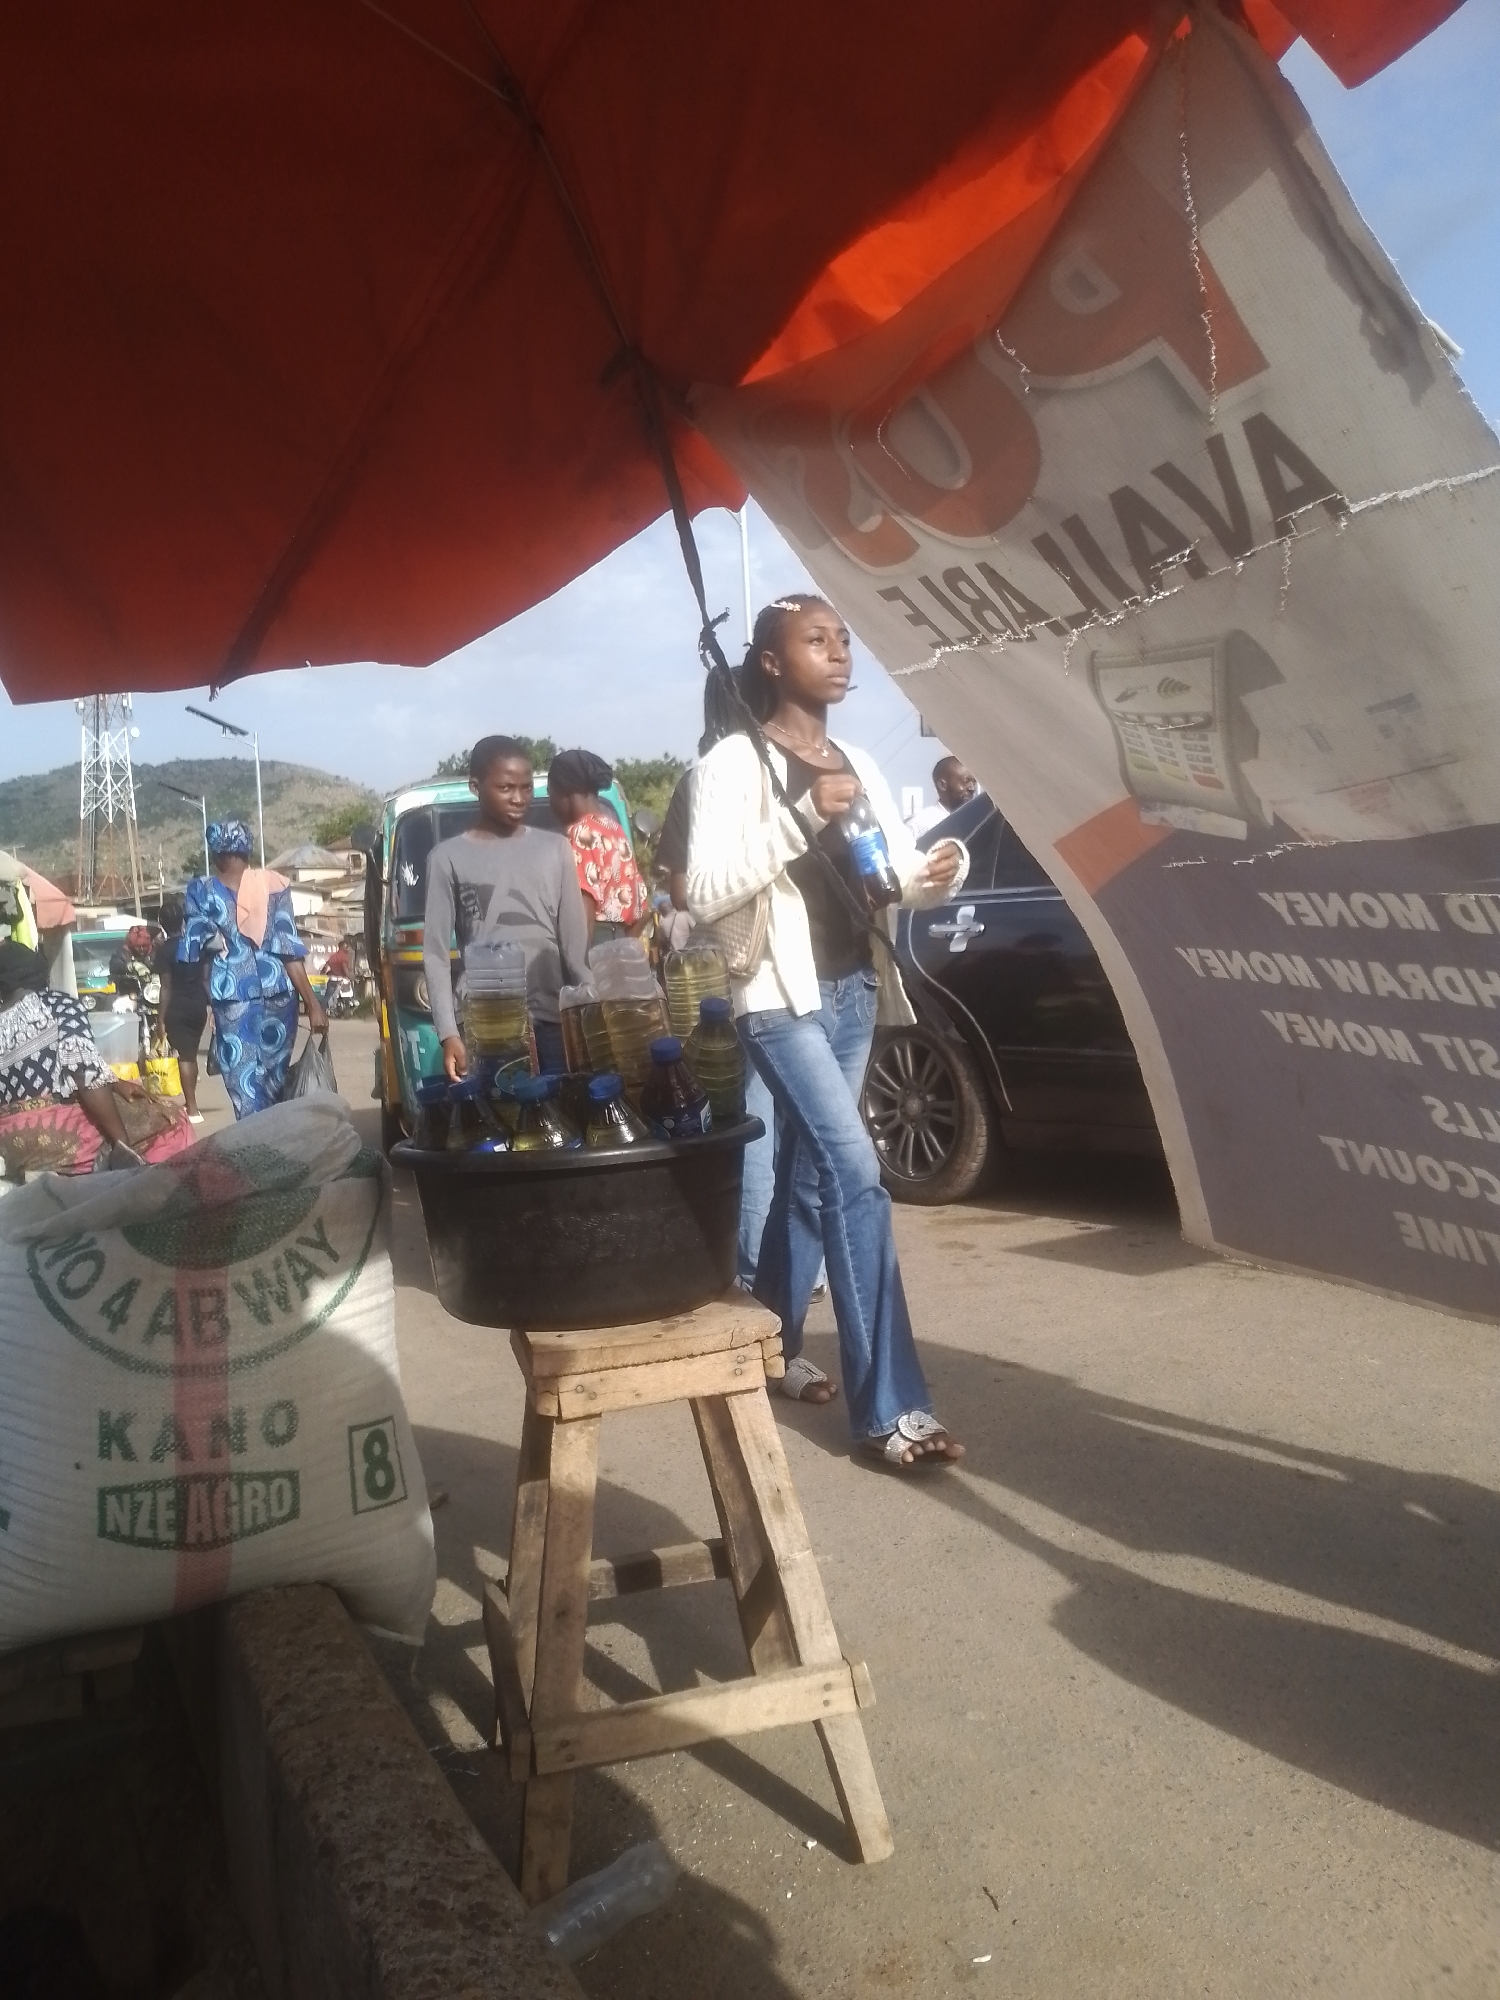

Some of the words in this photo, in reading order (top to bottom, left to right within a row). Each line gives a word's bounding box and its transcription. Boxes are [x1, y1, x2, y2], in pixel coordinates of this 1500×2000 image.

[97, 1399, 300, 1463] KANO
[361, 1427, 397, 1501] 8
[105, 1489, 178, 1537] NZE
[184, 1477, 295, 1544] AGRO
